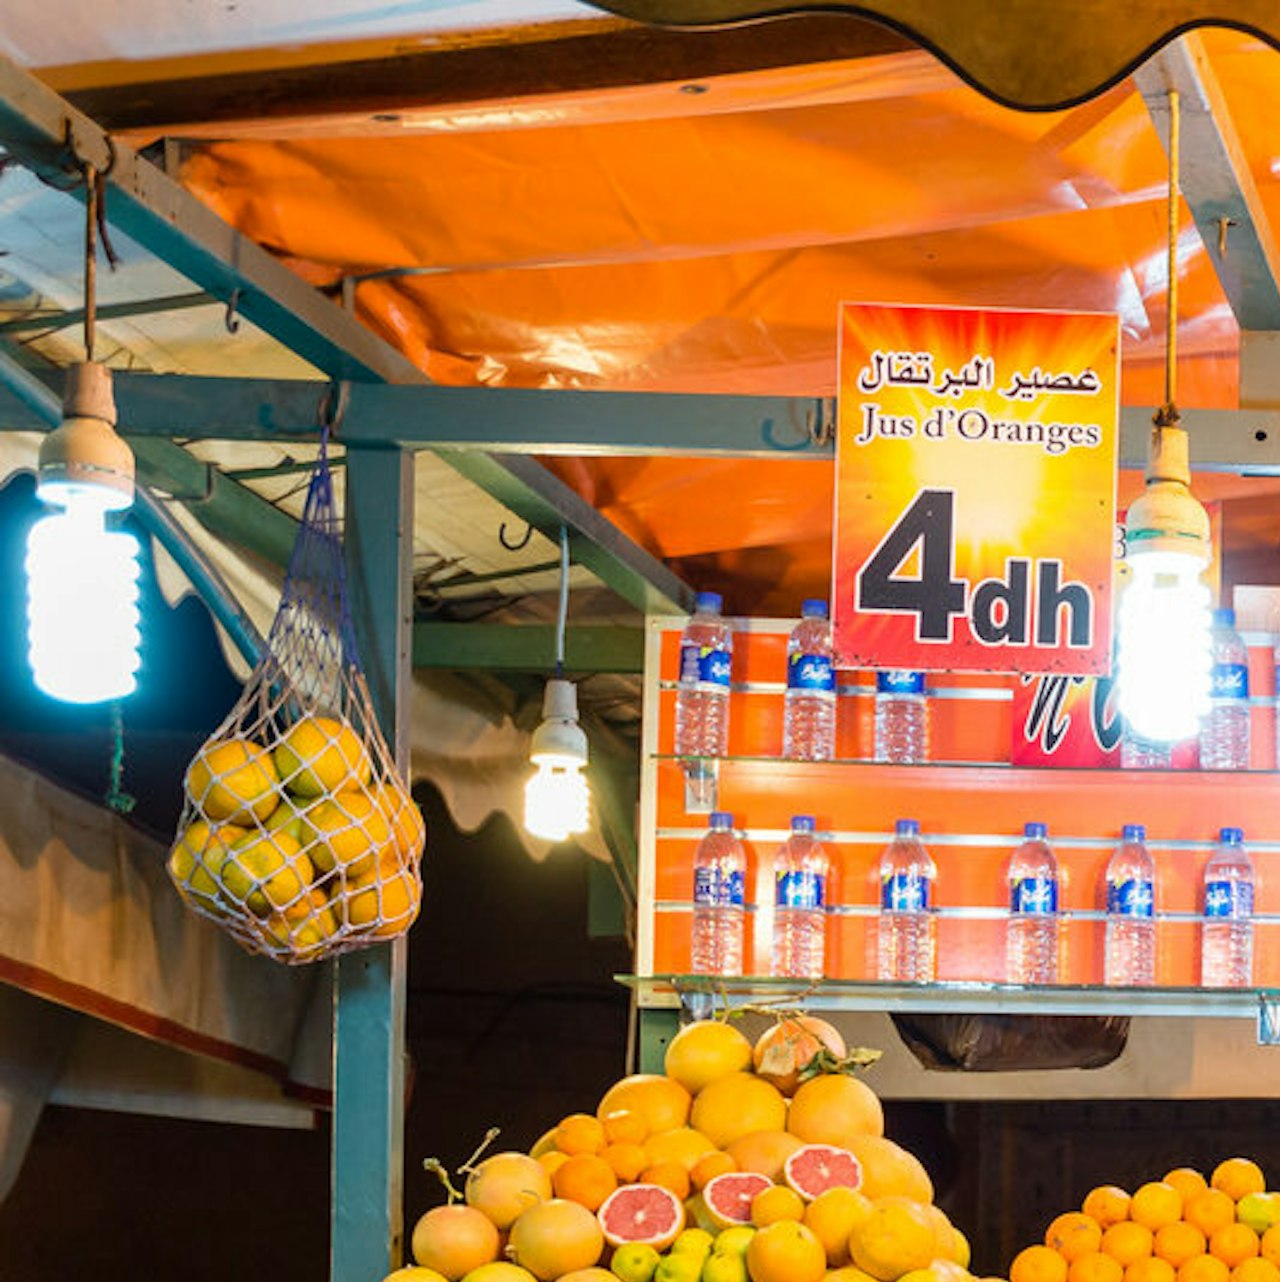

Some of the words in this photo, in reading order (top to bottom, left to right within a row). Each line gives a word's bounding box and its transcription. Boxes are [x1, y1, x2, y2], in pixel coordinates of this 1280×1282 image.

[861, 354, 993, 395] البرتقال
[859, 406, 913, 441] Jus
[924, 410, 1099, 453] d'Oranges
